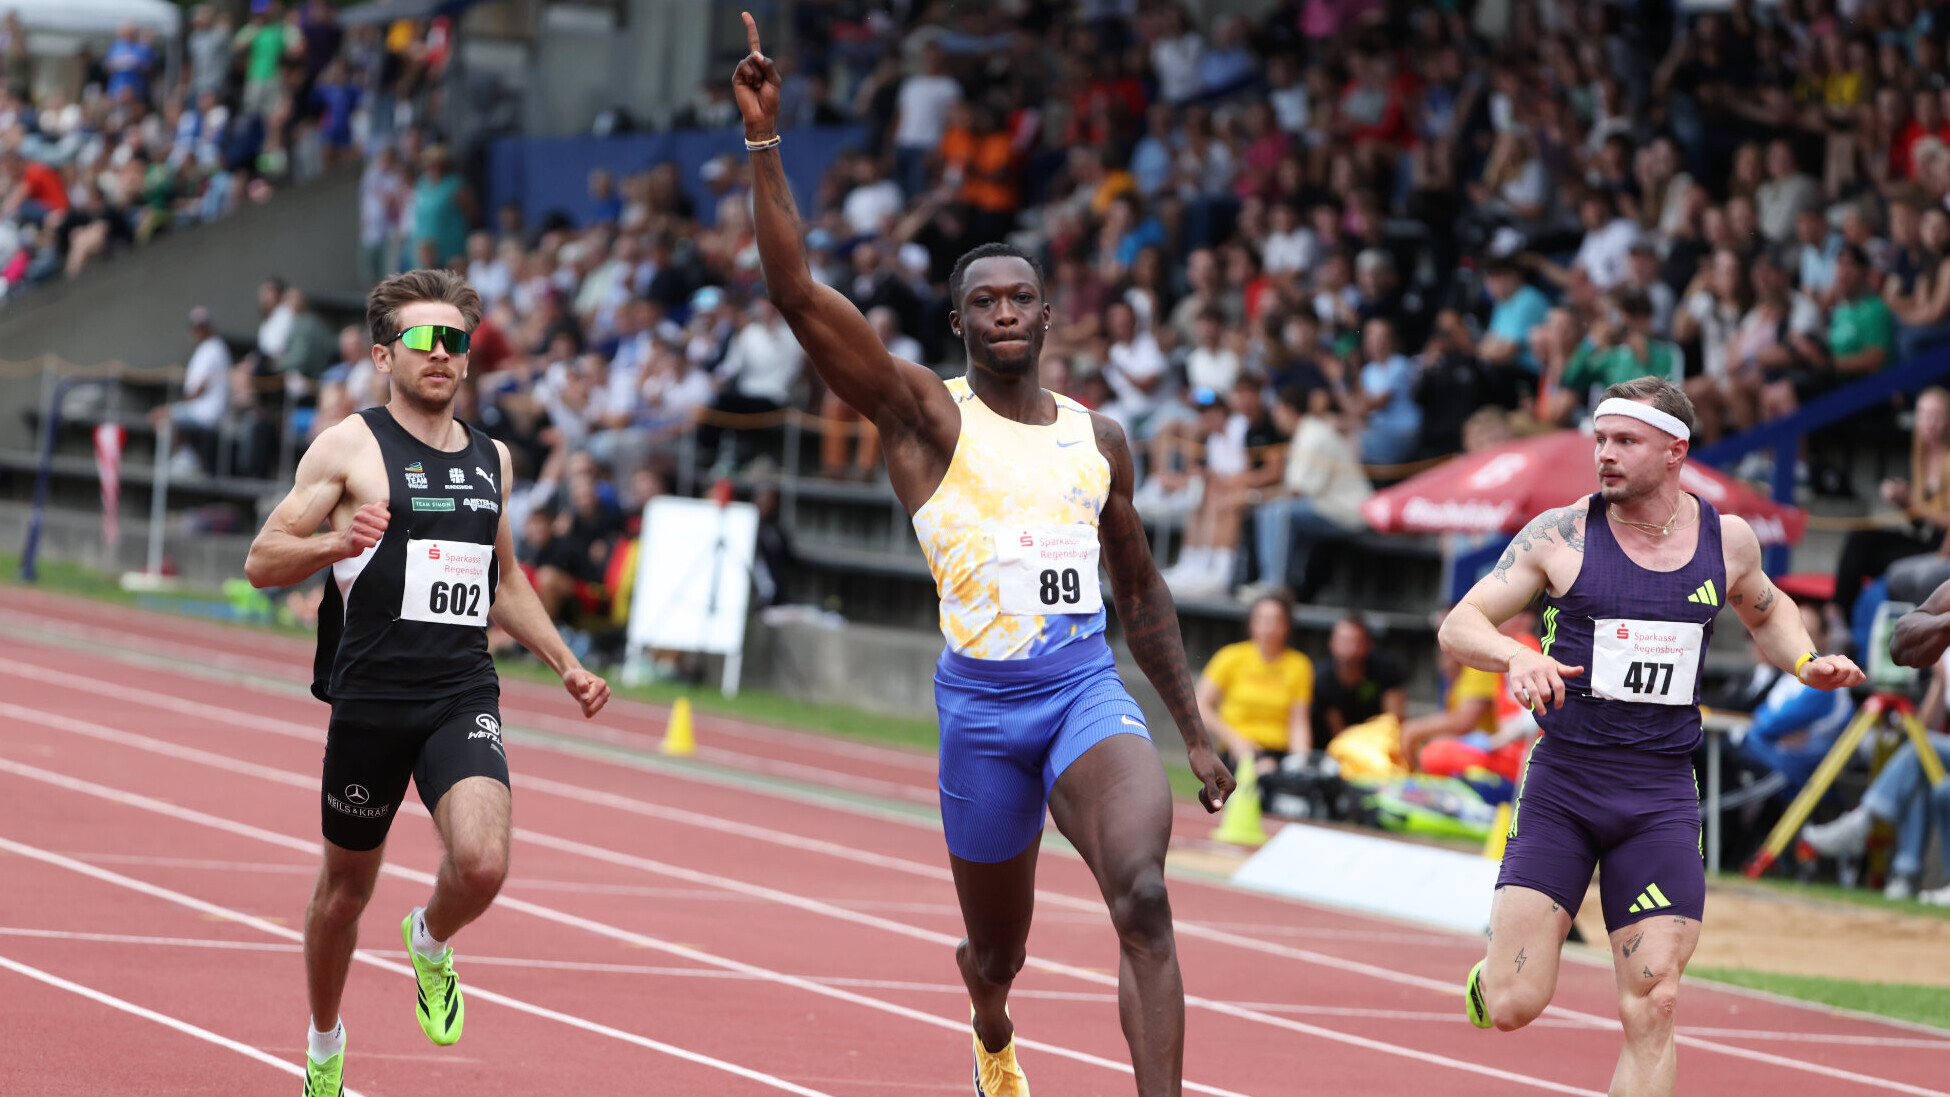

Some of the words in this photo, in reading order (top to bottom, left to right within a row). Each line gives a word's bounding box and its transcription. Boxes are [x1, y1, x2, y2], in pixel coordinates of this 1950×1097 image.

[406, 477, 428, 485] TEAM
[1040, 568, 1081, 606] 89
[429, 581, 481, 617] 602
[1634, 631, 1677, 643] Sparkasse
[1634, 644, 1684, 655] Regensburg
[1623, 661, 1674, 696] 477
